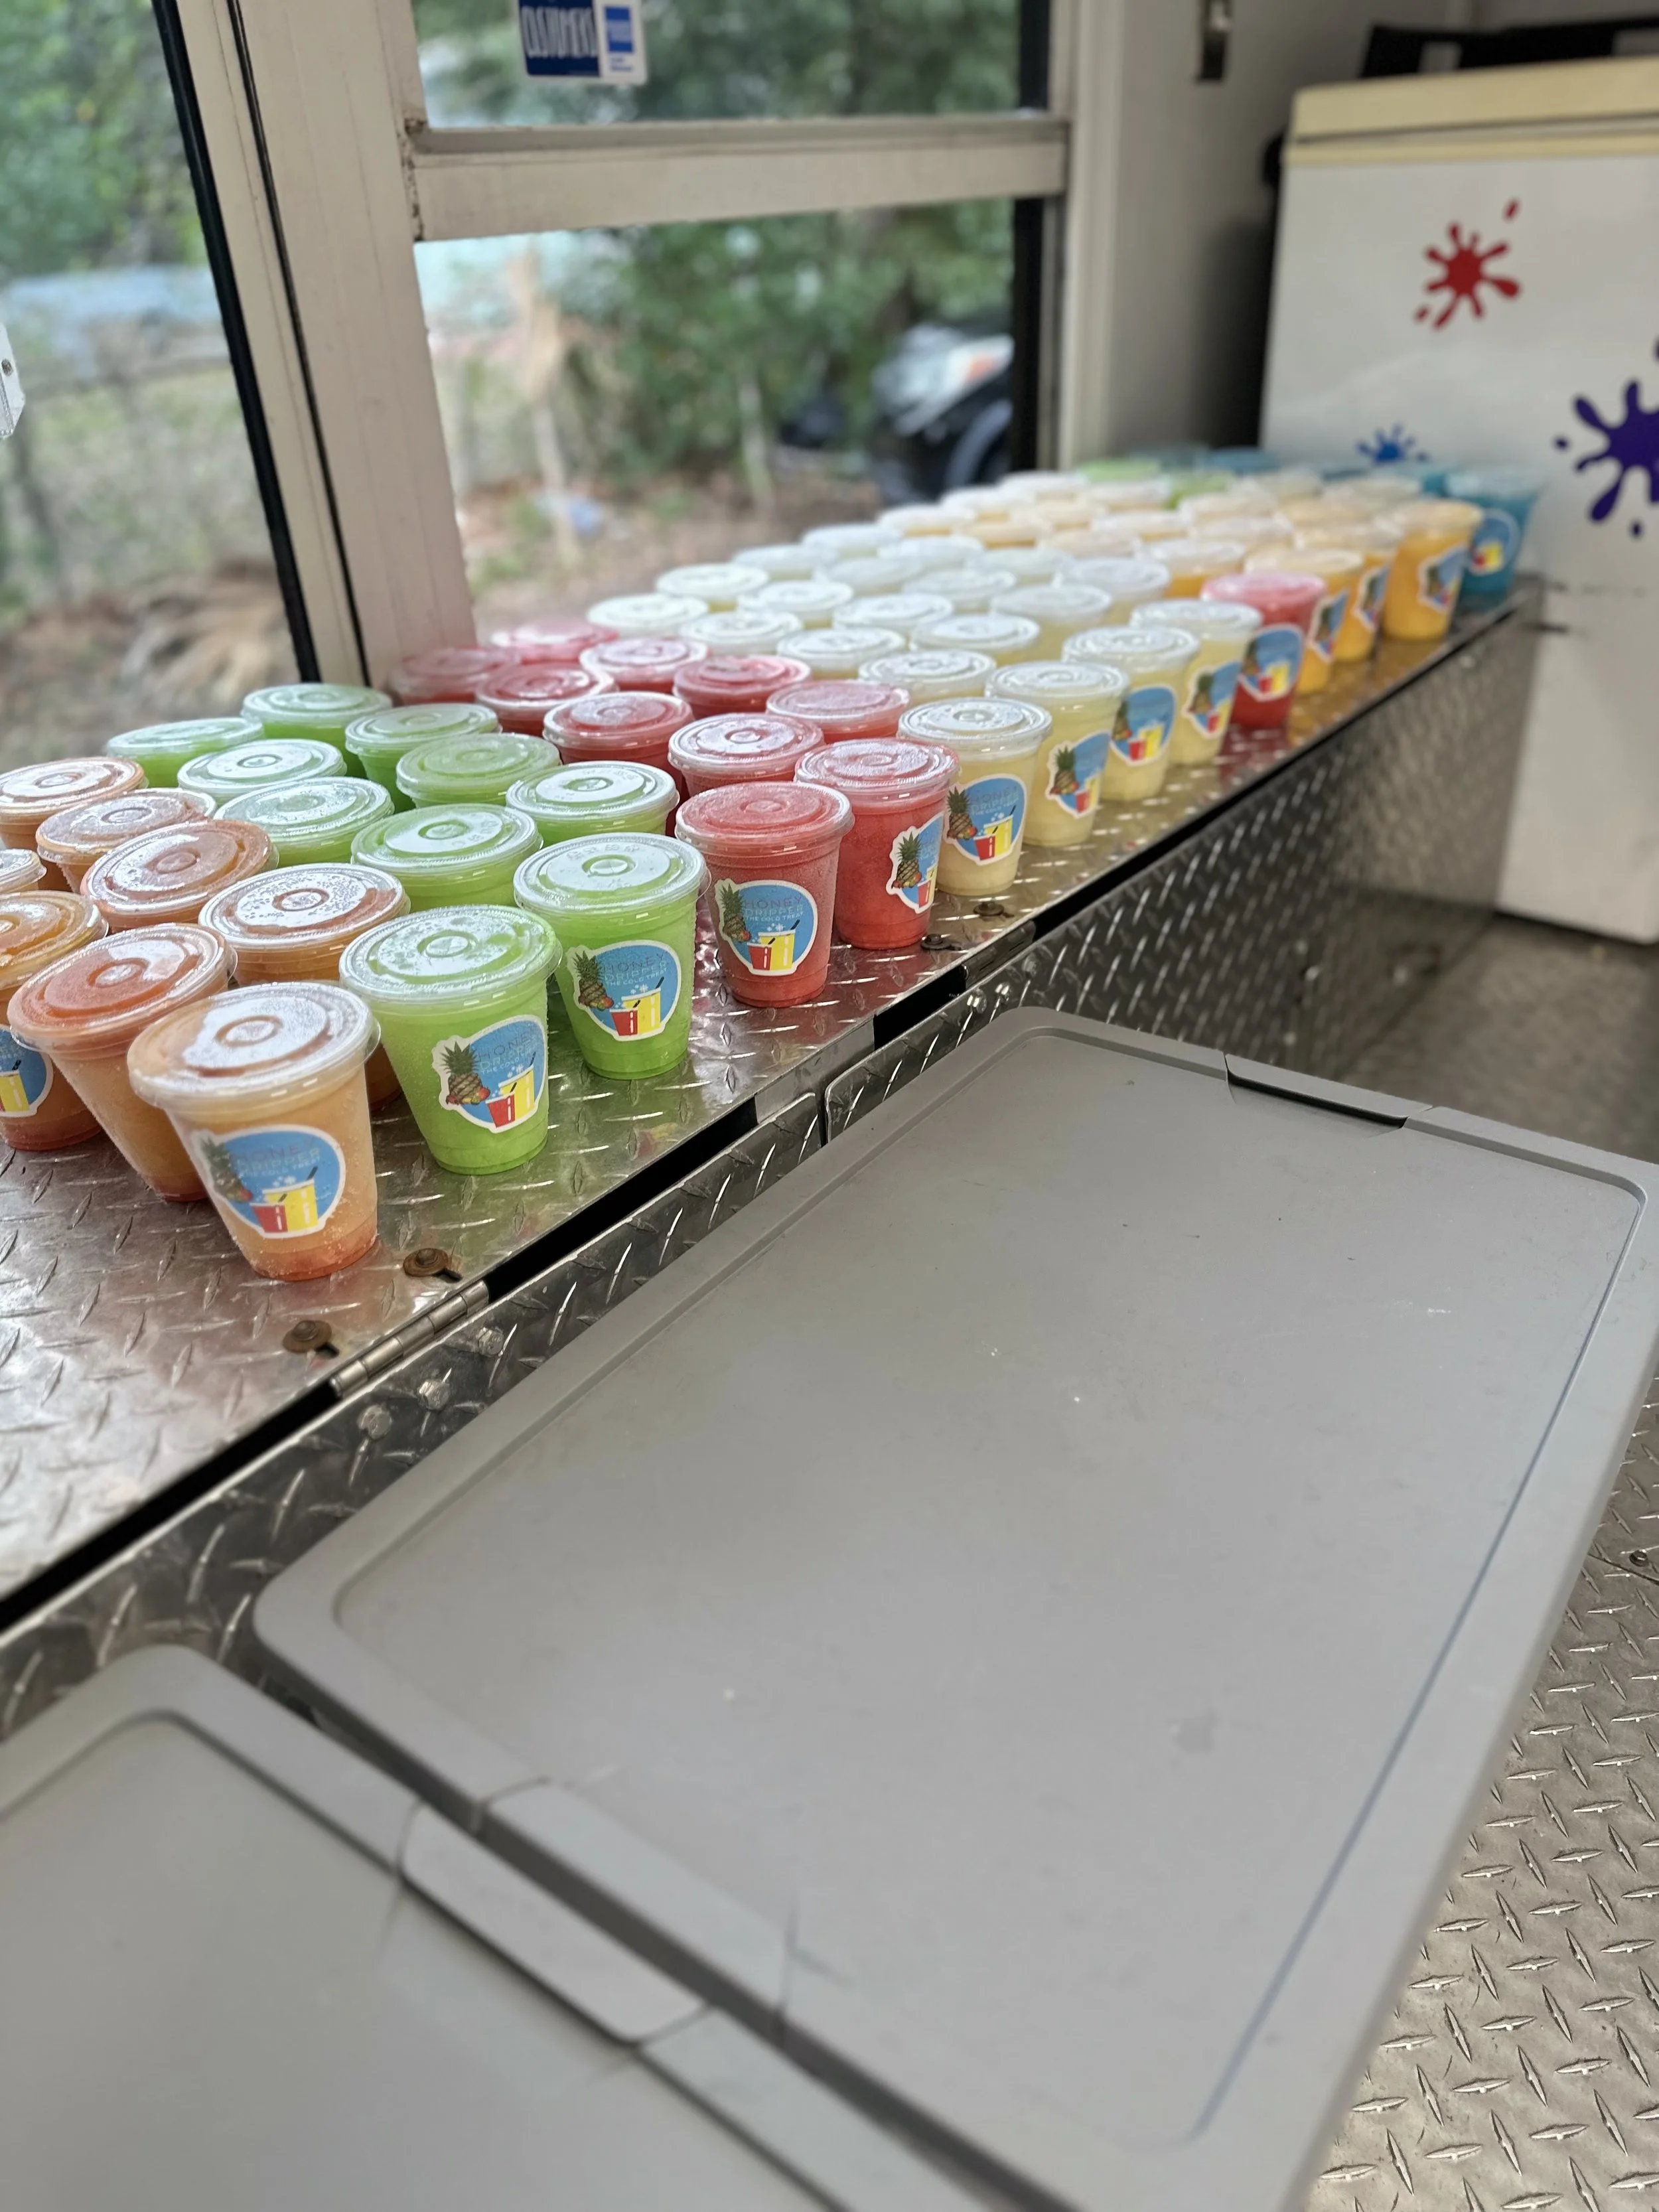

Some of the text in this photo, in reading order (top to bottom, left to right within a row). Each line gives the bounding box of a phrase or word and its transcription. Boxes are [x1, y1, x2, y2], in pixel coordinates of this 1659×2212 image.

[743, 895, 802, 909] HONEY
[745, 904, 804, 917] DRIPPER
[782, 911, 804, 921] TREAT
[602, 953, 664, 974] HONEY
[605, 960, 668, 982] DRIPPER
[623, 976, 644, 985] COLD
[645, 968, 668, 979] TREAT
[230, 1137, 315, 1165] HONEY
[237, 1147, 320, 1173] DRIPPER
[260, 1167, 289, 1177] COLD
